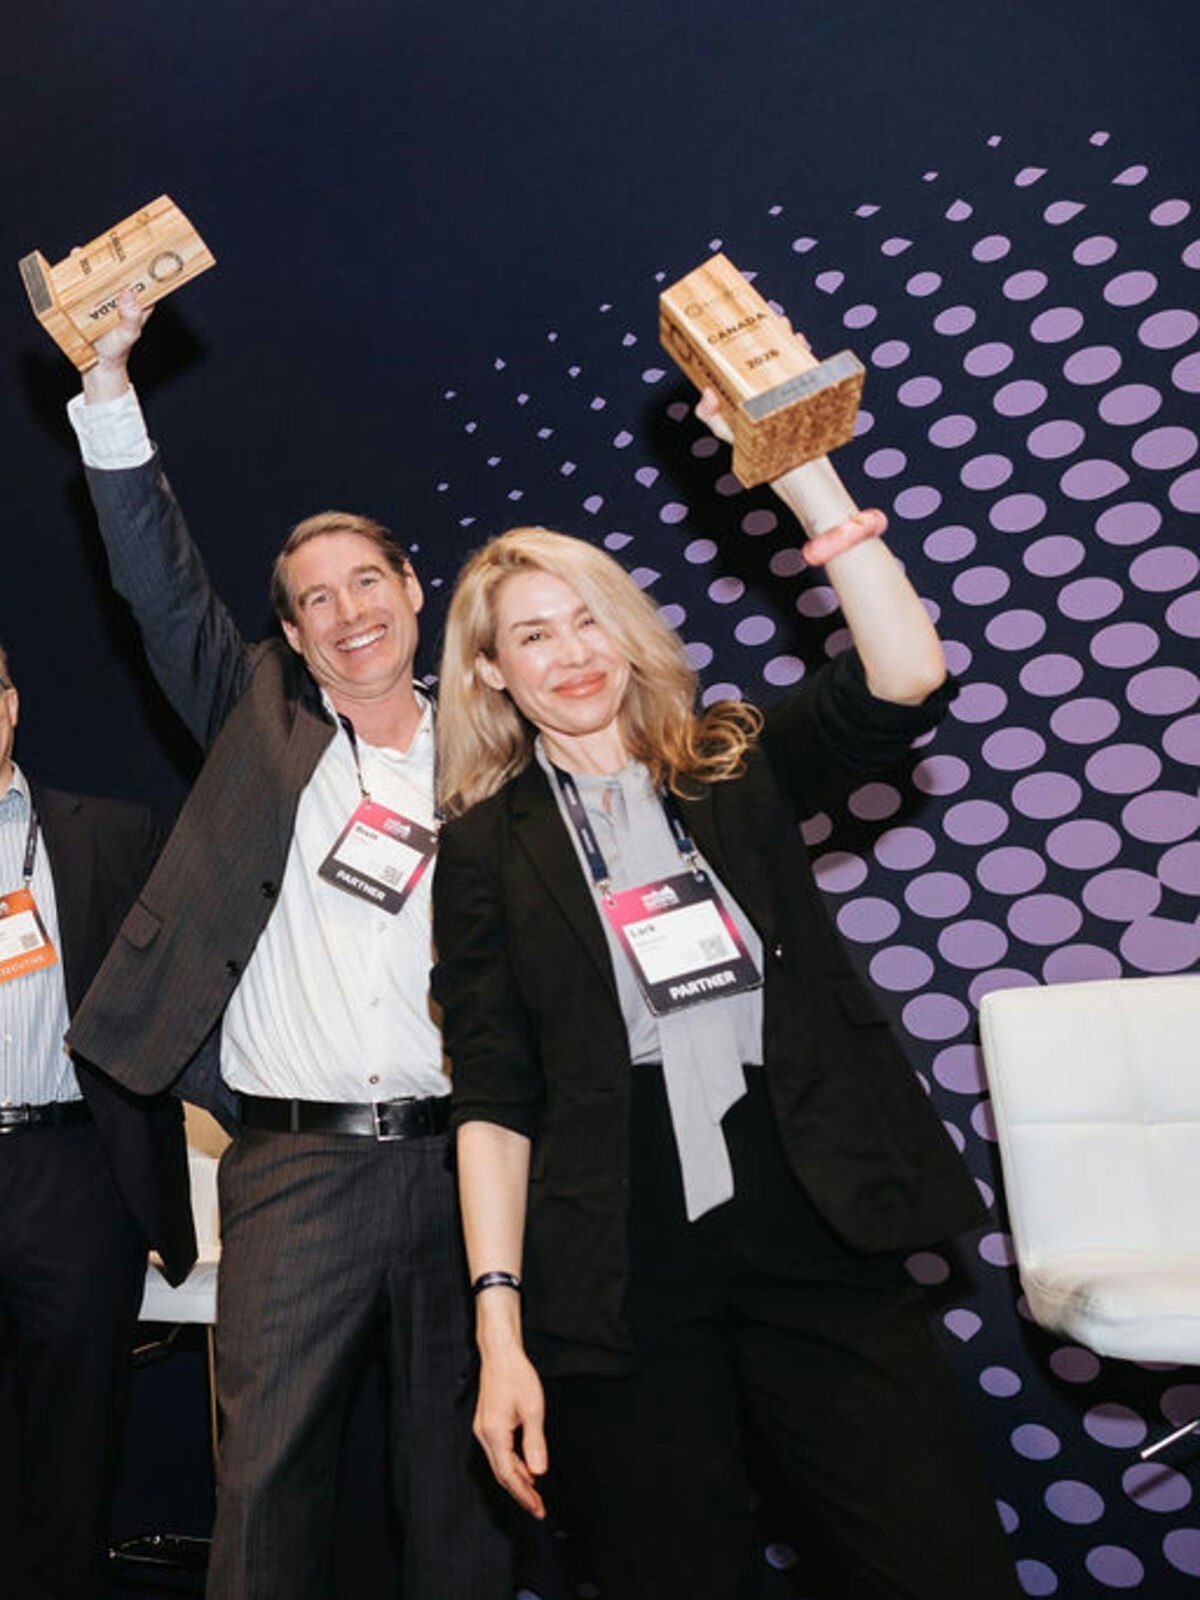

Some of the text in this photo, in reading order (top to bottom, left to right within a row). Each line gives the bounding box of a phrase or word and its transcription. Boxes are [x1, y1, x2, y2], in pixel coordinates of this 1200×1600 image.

[89, 282, 146, 320] CADA
[707, 312, 767, 345] CANADA
[335, 868, 387, 901] PARTNER
[668, 970, 738, 1001] PARTNER
